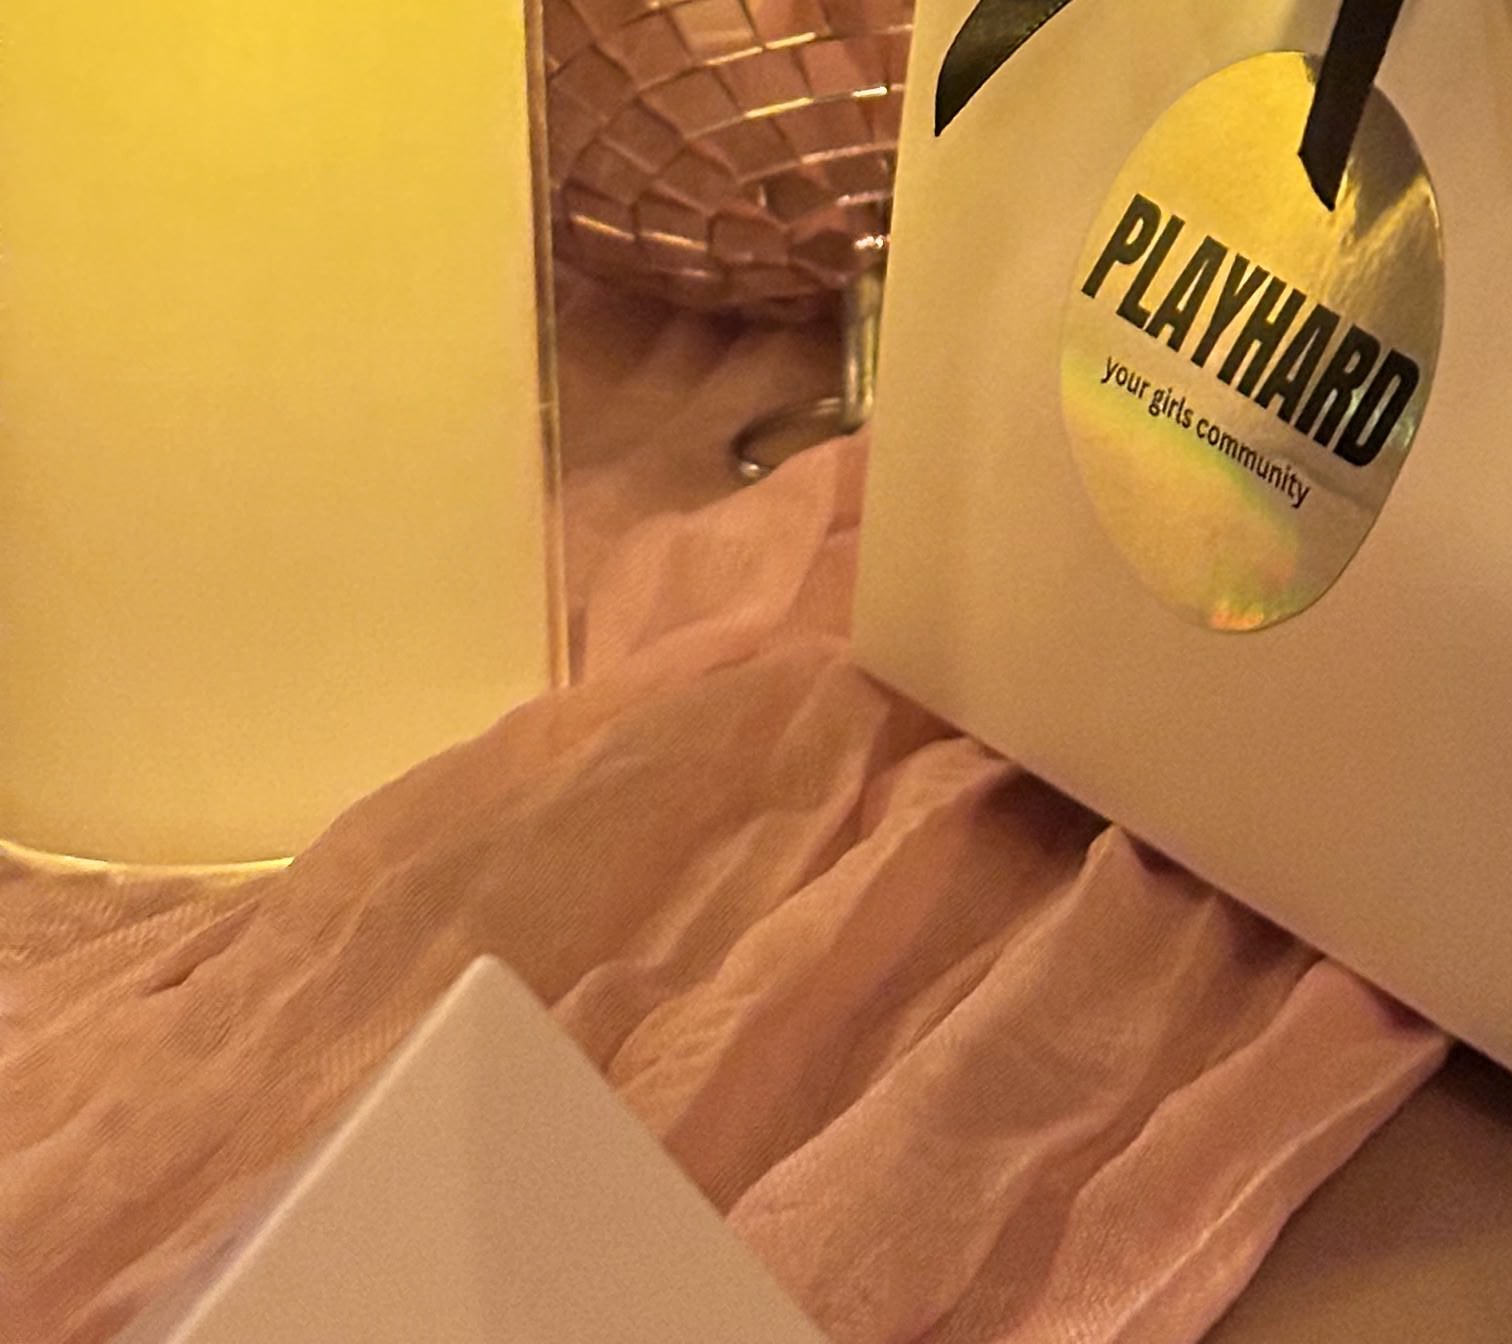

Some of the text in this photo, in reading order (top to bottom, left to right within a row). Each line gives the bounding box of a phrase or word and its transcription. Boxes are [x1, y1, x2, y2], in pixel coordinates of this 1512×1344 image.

[1081, 193, 1420, 467] PLAYHARD
[1101, 356, 1310, 509] your girls community
